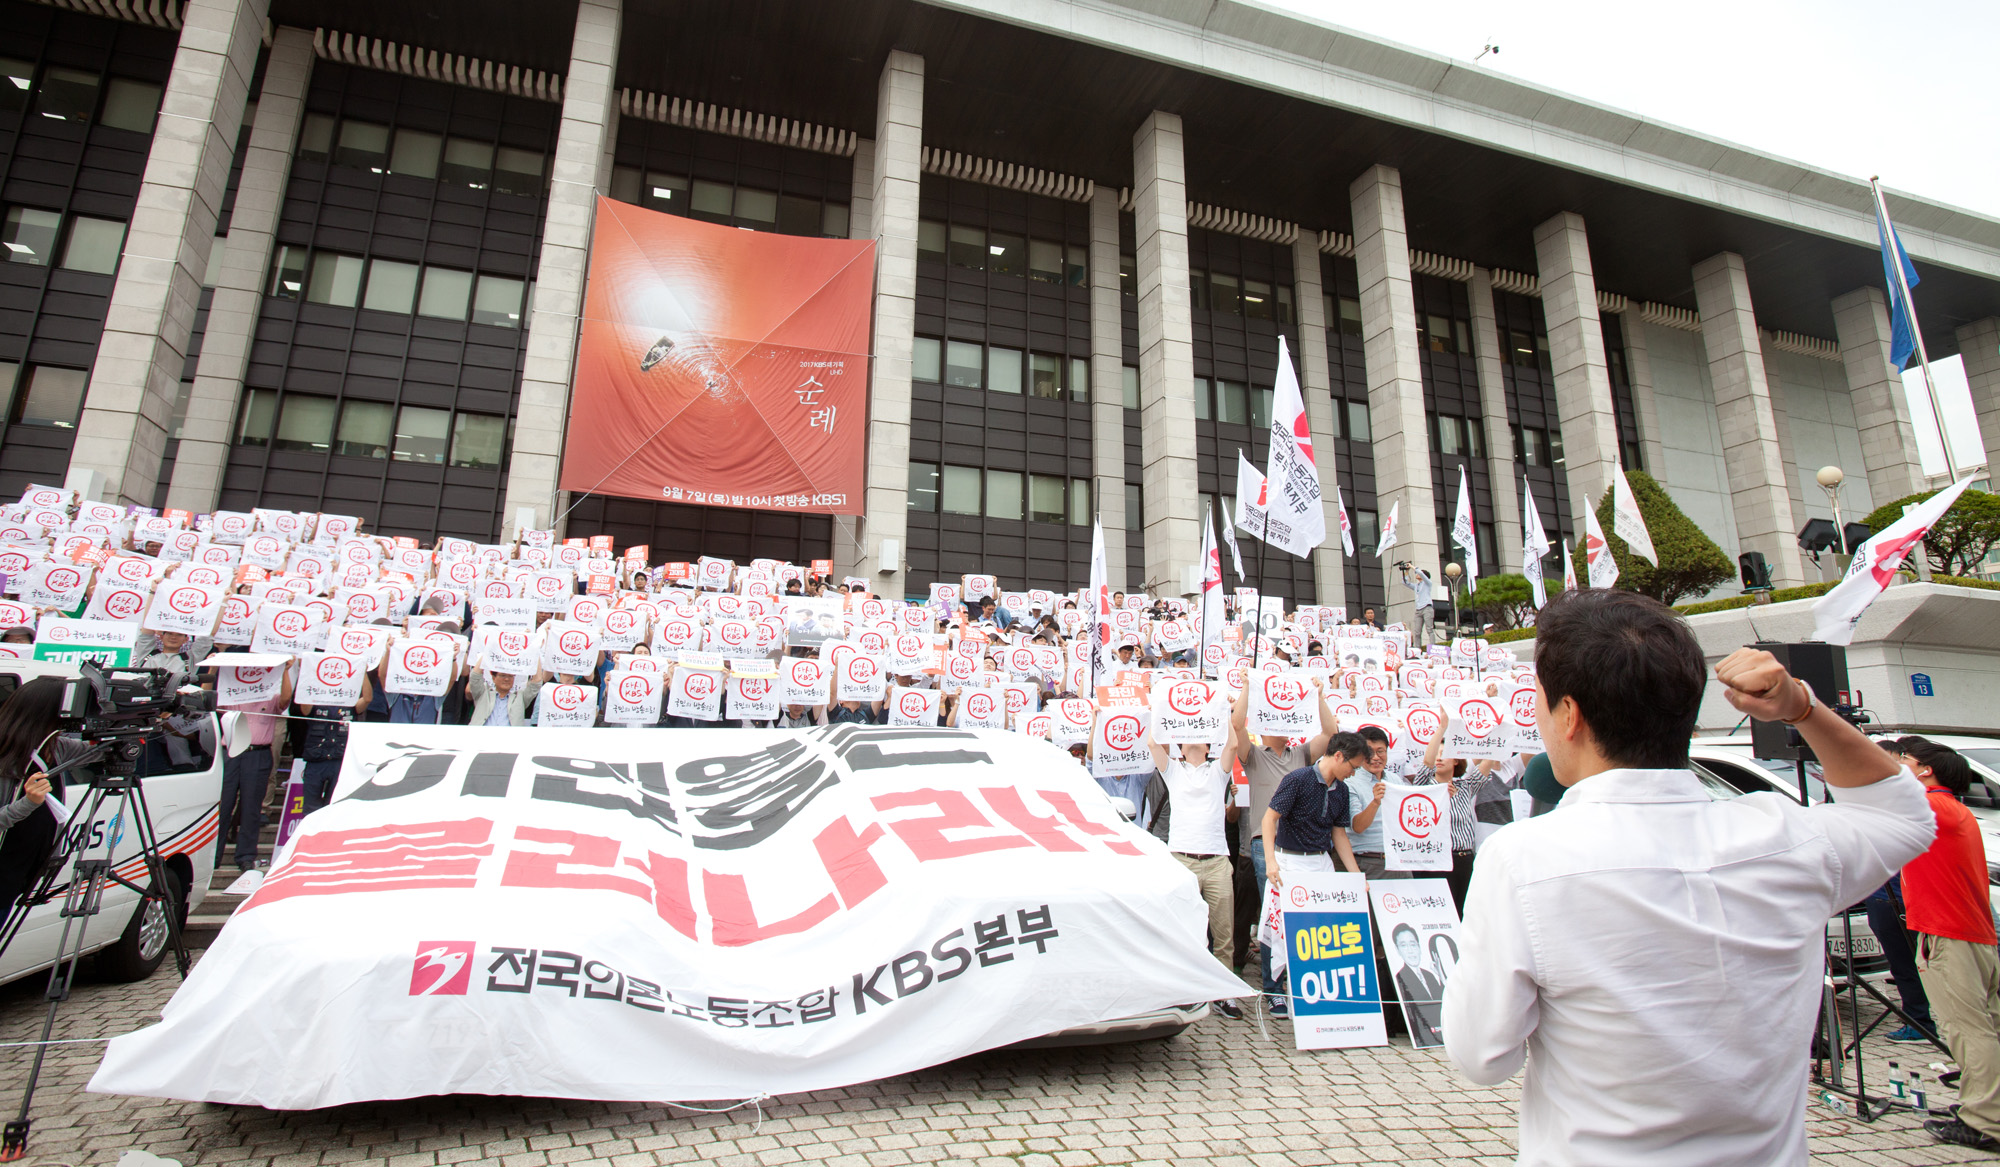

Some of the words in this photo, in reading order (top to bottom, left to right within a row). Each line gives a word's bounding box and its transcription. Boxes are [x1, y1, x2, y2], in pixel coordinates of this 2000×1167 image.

[662, 486, 684, 500] 9월
[686, 490, 706, 503] 7일
[708, 493, 730, 505] (목)
[773, 496, 810, 507] 첫방송
[812, 493, 847, 505] KBS1
[31, 590, 50, 598] 국민의
[180, 593, 199, 601] 다시
[157, 612, 178, 621] 국민의
[282, 615, 300, 623] 다시
[263, 636, 282, 646] 국민의
[503, 634, 522, 642] 다시
[412, 652, 429, 660] 다시
[490, 652, 506, 661] 국민의
[552, 654, 570, 663] 국민의
[325, 662, 344, 670] 다시
[394, 674, 413, 683] 국민의
[691, 678, 708, 686] 다시
[626, 682, 642, 690] 다시
[1272, 681, 1292, 690] 다시
[1918, 684, 1929, 695] 13
[306, 686, 327, 696] 국민의
[559, 689, 578, 697] 다시
[787, 688, 802, 696] 국민의
[1108, 688, 1135, 697] 퇴진!
[1177, 686, 1199, 696] 다시
[675, 699, 691, 708] 국민의
[734, 701, 750, 710] 국민의
[905, 698, 921, 706] 다시
[613, 704, 630, 713] 국민의
[1465, 708, 1486, 718] 다시
[546, 712, 564, 721] 국민의
[1257, 710, 1278, 721] 국민의
[1283, 714, 1312, 725] 방송으로!
[894, 717, 909, 726] 국민의
[965, 719, 978, 727] 국민의
[1161, 717, 1185, 730] 국민의
[1188, 716, 1219, 729] 방송으로!
[1112, 724, 1132, 732] 다시
[1452, 735, 1473, 747] 국민의
[1476, 737, 1506, 748] 방송으로!
[1099, 752, 1119, 762] 국민의
[1121, 751, 1149, 762] 방송으로!
[1408, 802, 1428, 814] 다시
[1391, 839, 1413, 851] 국민의
[1416, 841, 1443, 854] 방송으로!
[235, 785, 1147, 946] 물러나라!
[1311, 890, 1330, 902] 국민의
[1332, 891, 1358, 903] 방송으로!
[1402, 897, 1421, 909] 국민의
[1421, 896, 1446, 907] 방송으로!
[1296, 922, 1364, 962] 이인호
[486, 946, 840, 1029] 전국언론노동조합
[852, 904, 1060, 1016] KBS본부
[1300, 964, 1367, 1005] OUT!
